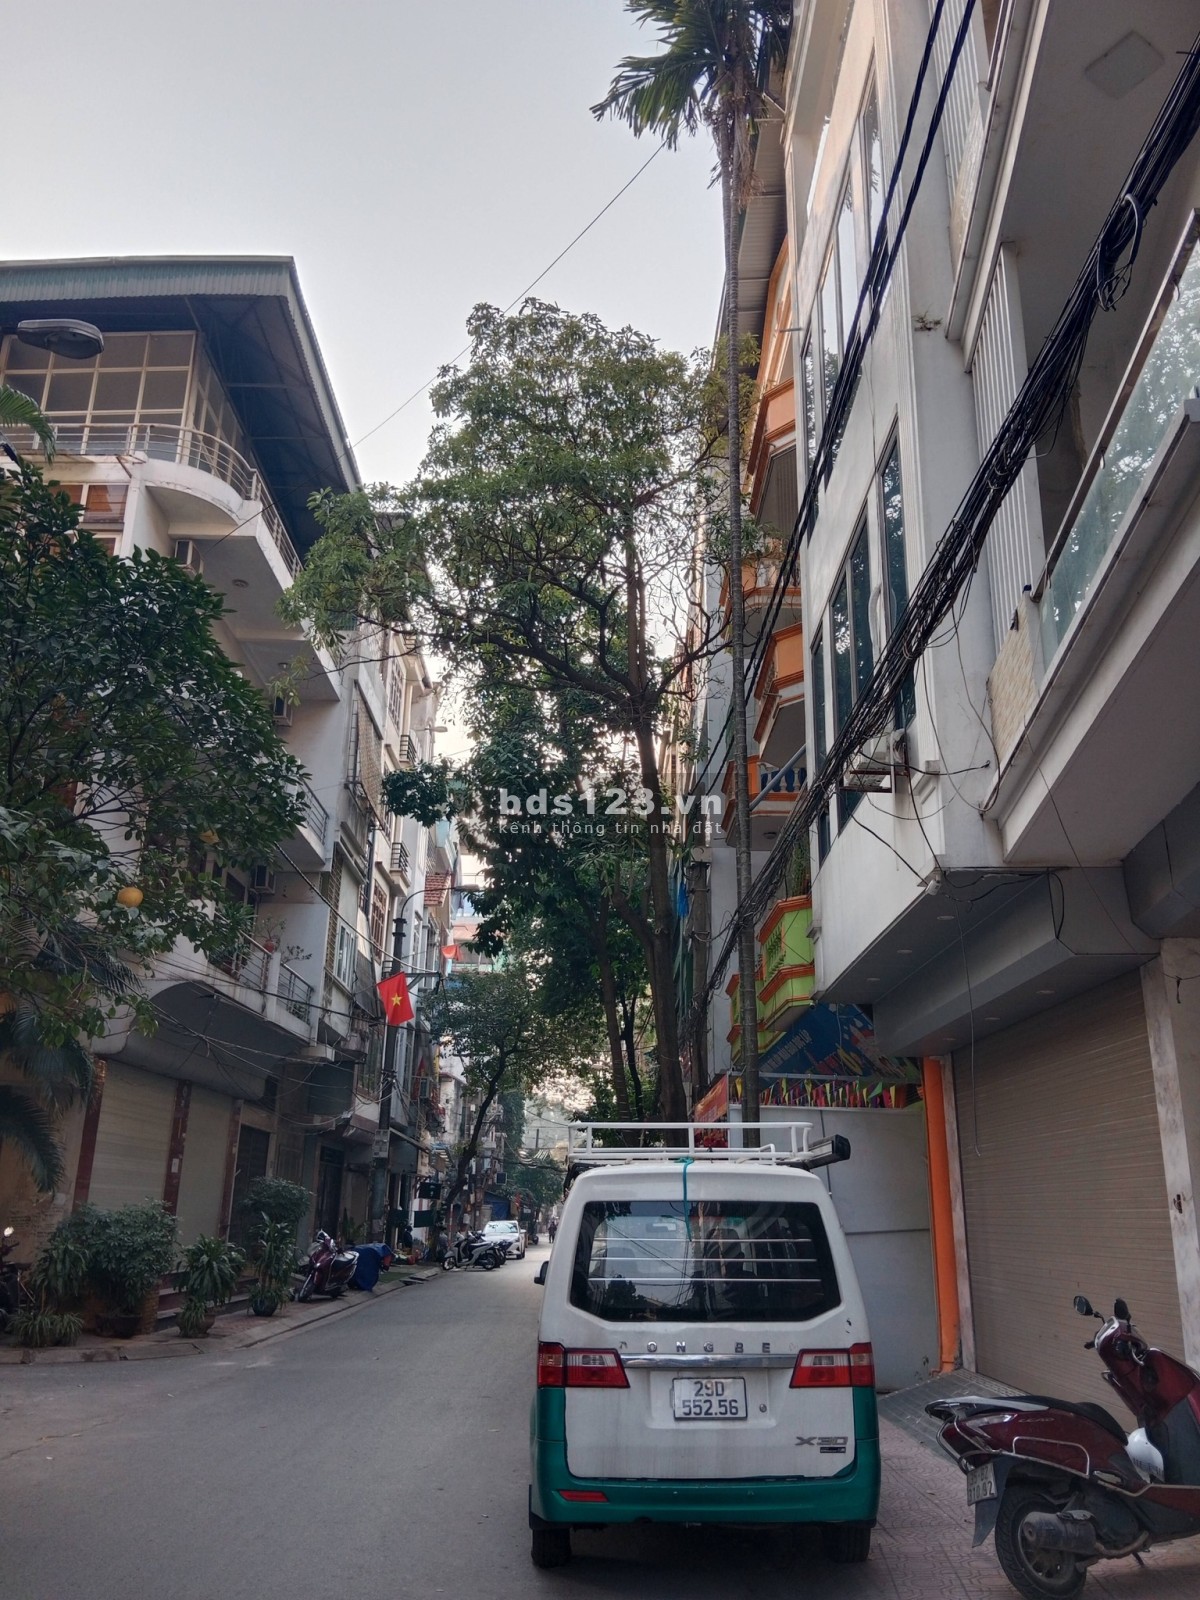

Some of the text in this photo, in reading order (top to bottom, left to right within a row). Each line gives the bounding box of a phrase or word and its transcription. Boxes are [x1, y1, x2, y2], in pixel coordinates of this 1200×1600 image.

[619, 1340, 798, 1354] ONGBE
[694, 1380, 725, 1397] 29D
[682, 1399, 739, 1416] 552.56
[795, 1436, 848, 1446] X30
